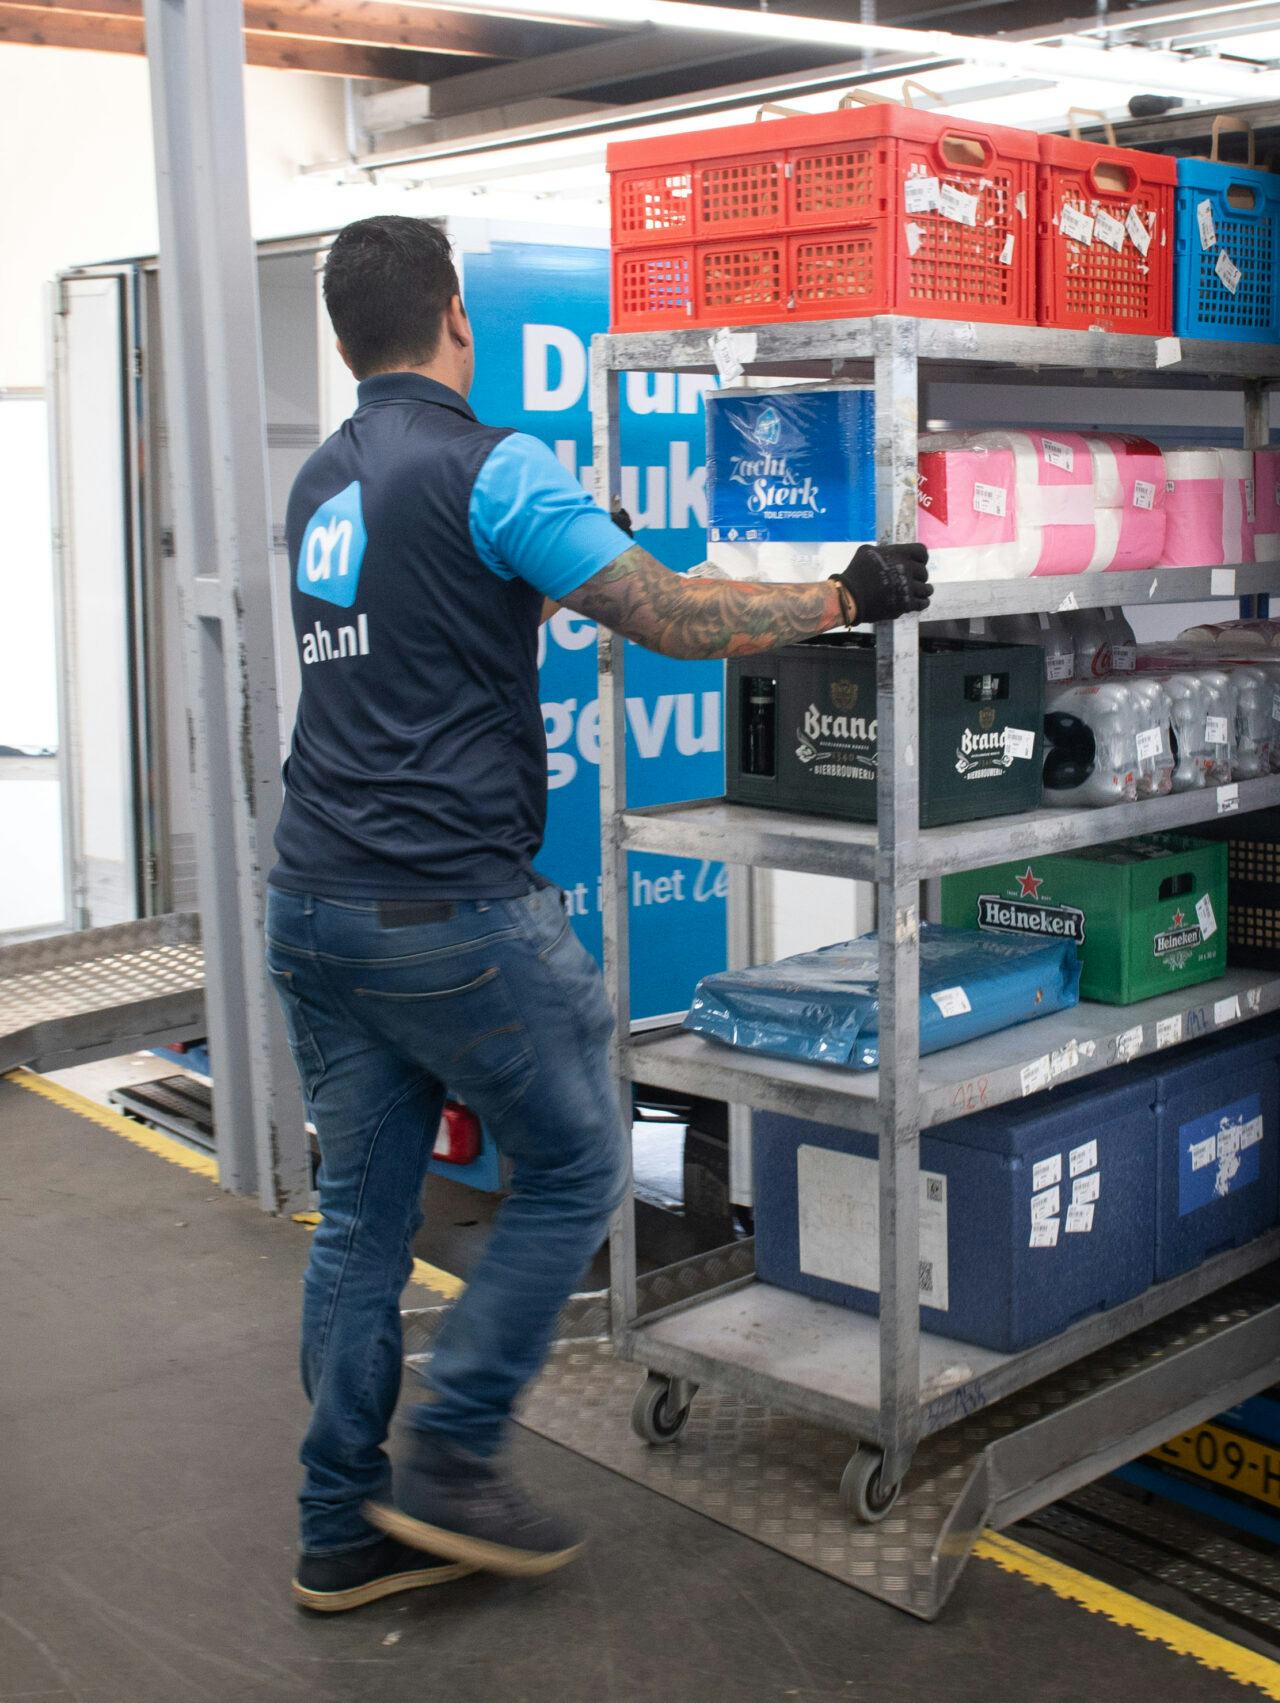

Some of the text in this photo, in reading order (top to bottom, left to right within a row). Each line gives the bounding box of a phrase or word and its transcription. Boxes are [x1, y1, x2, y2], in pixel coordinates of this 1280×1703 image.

[302, 613, 370, 665] ah.nl
[633, 869, 685, 907] het
[985, 901, 1077, 937] Heineken
[1157, 931, 1198, 951] Heineken
